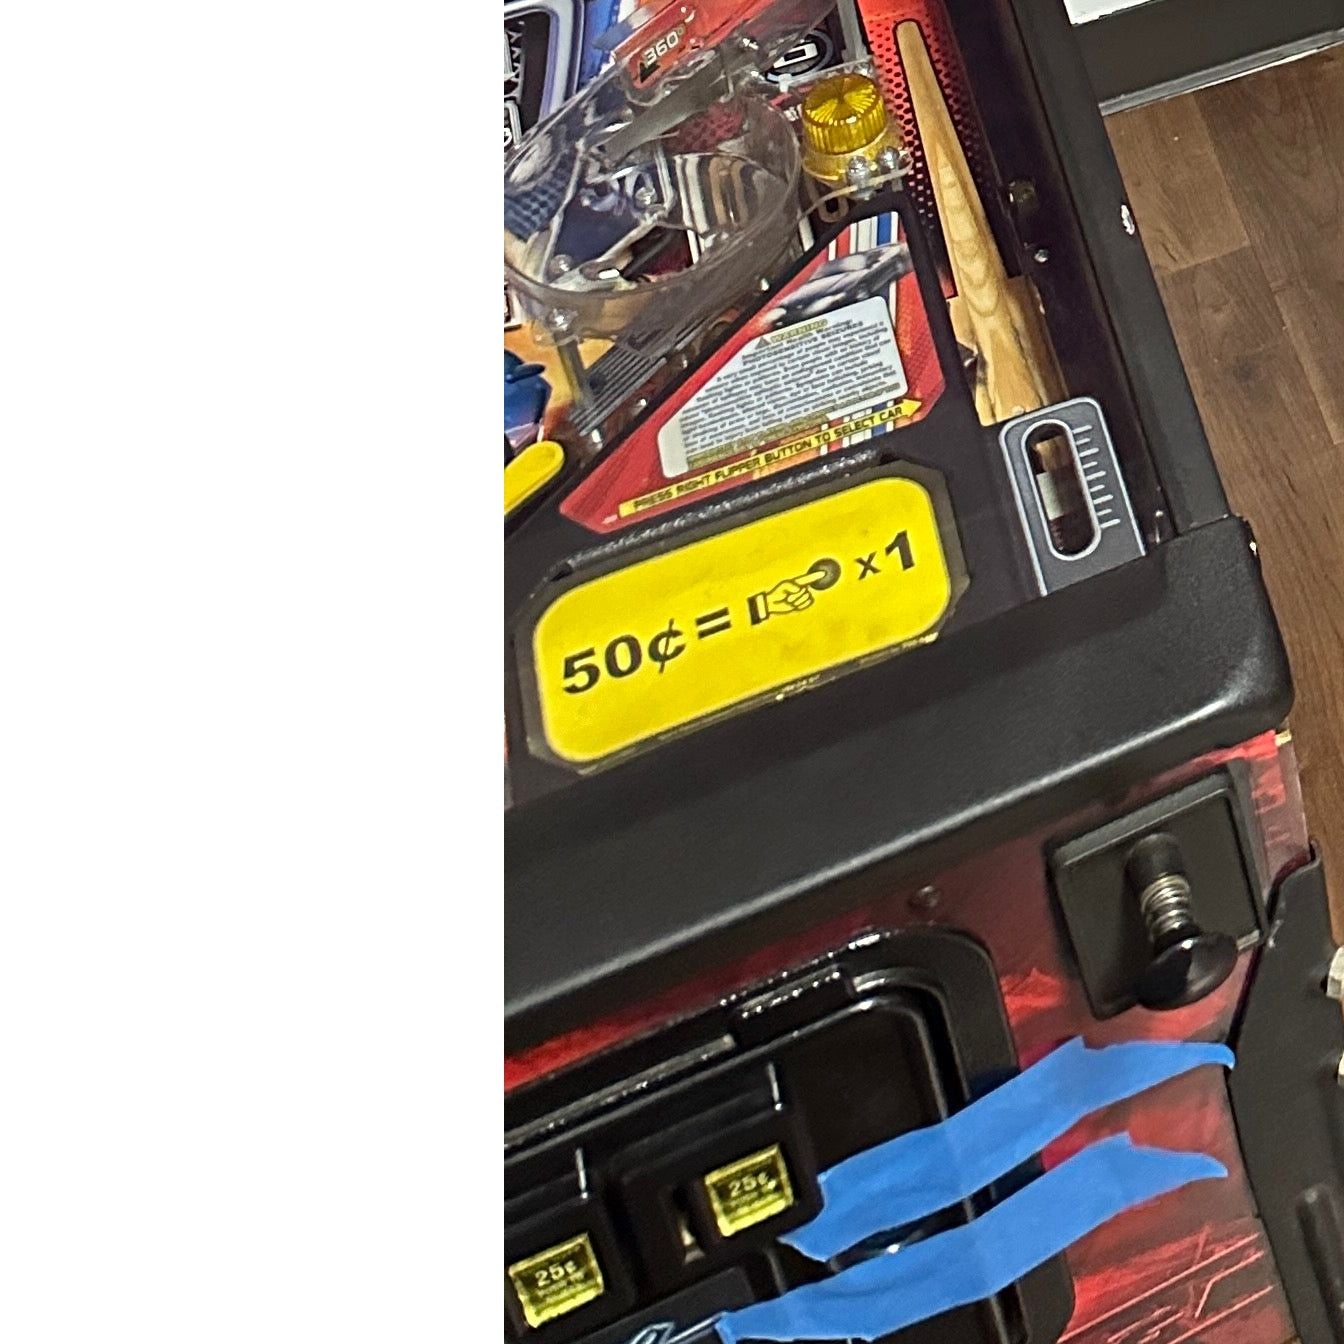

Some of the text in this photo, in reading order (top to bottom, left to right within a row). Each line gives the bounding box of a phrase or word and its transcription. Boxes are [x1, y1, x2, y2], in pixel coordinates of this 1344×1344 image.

[633, 406, 903, 511] PRESS RIGHT FLIPPER BUTTON TO SELECT CAR
[562, 617, 687, 695] 50¢
[728, 1170, 769, 1199] 25¢
[534, 1259, 578, 1289] 25¢
